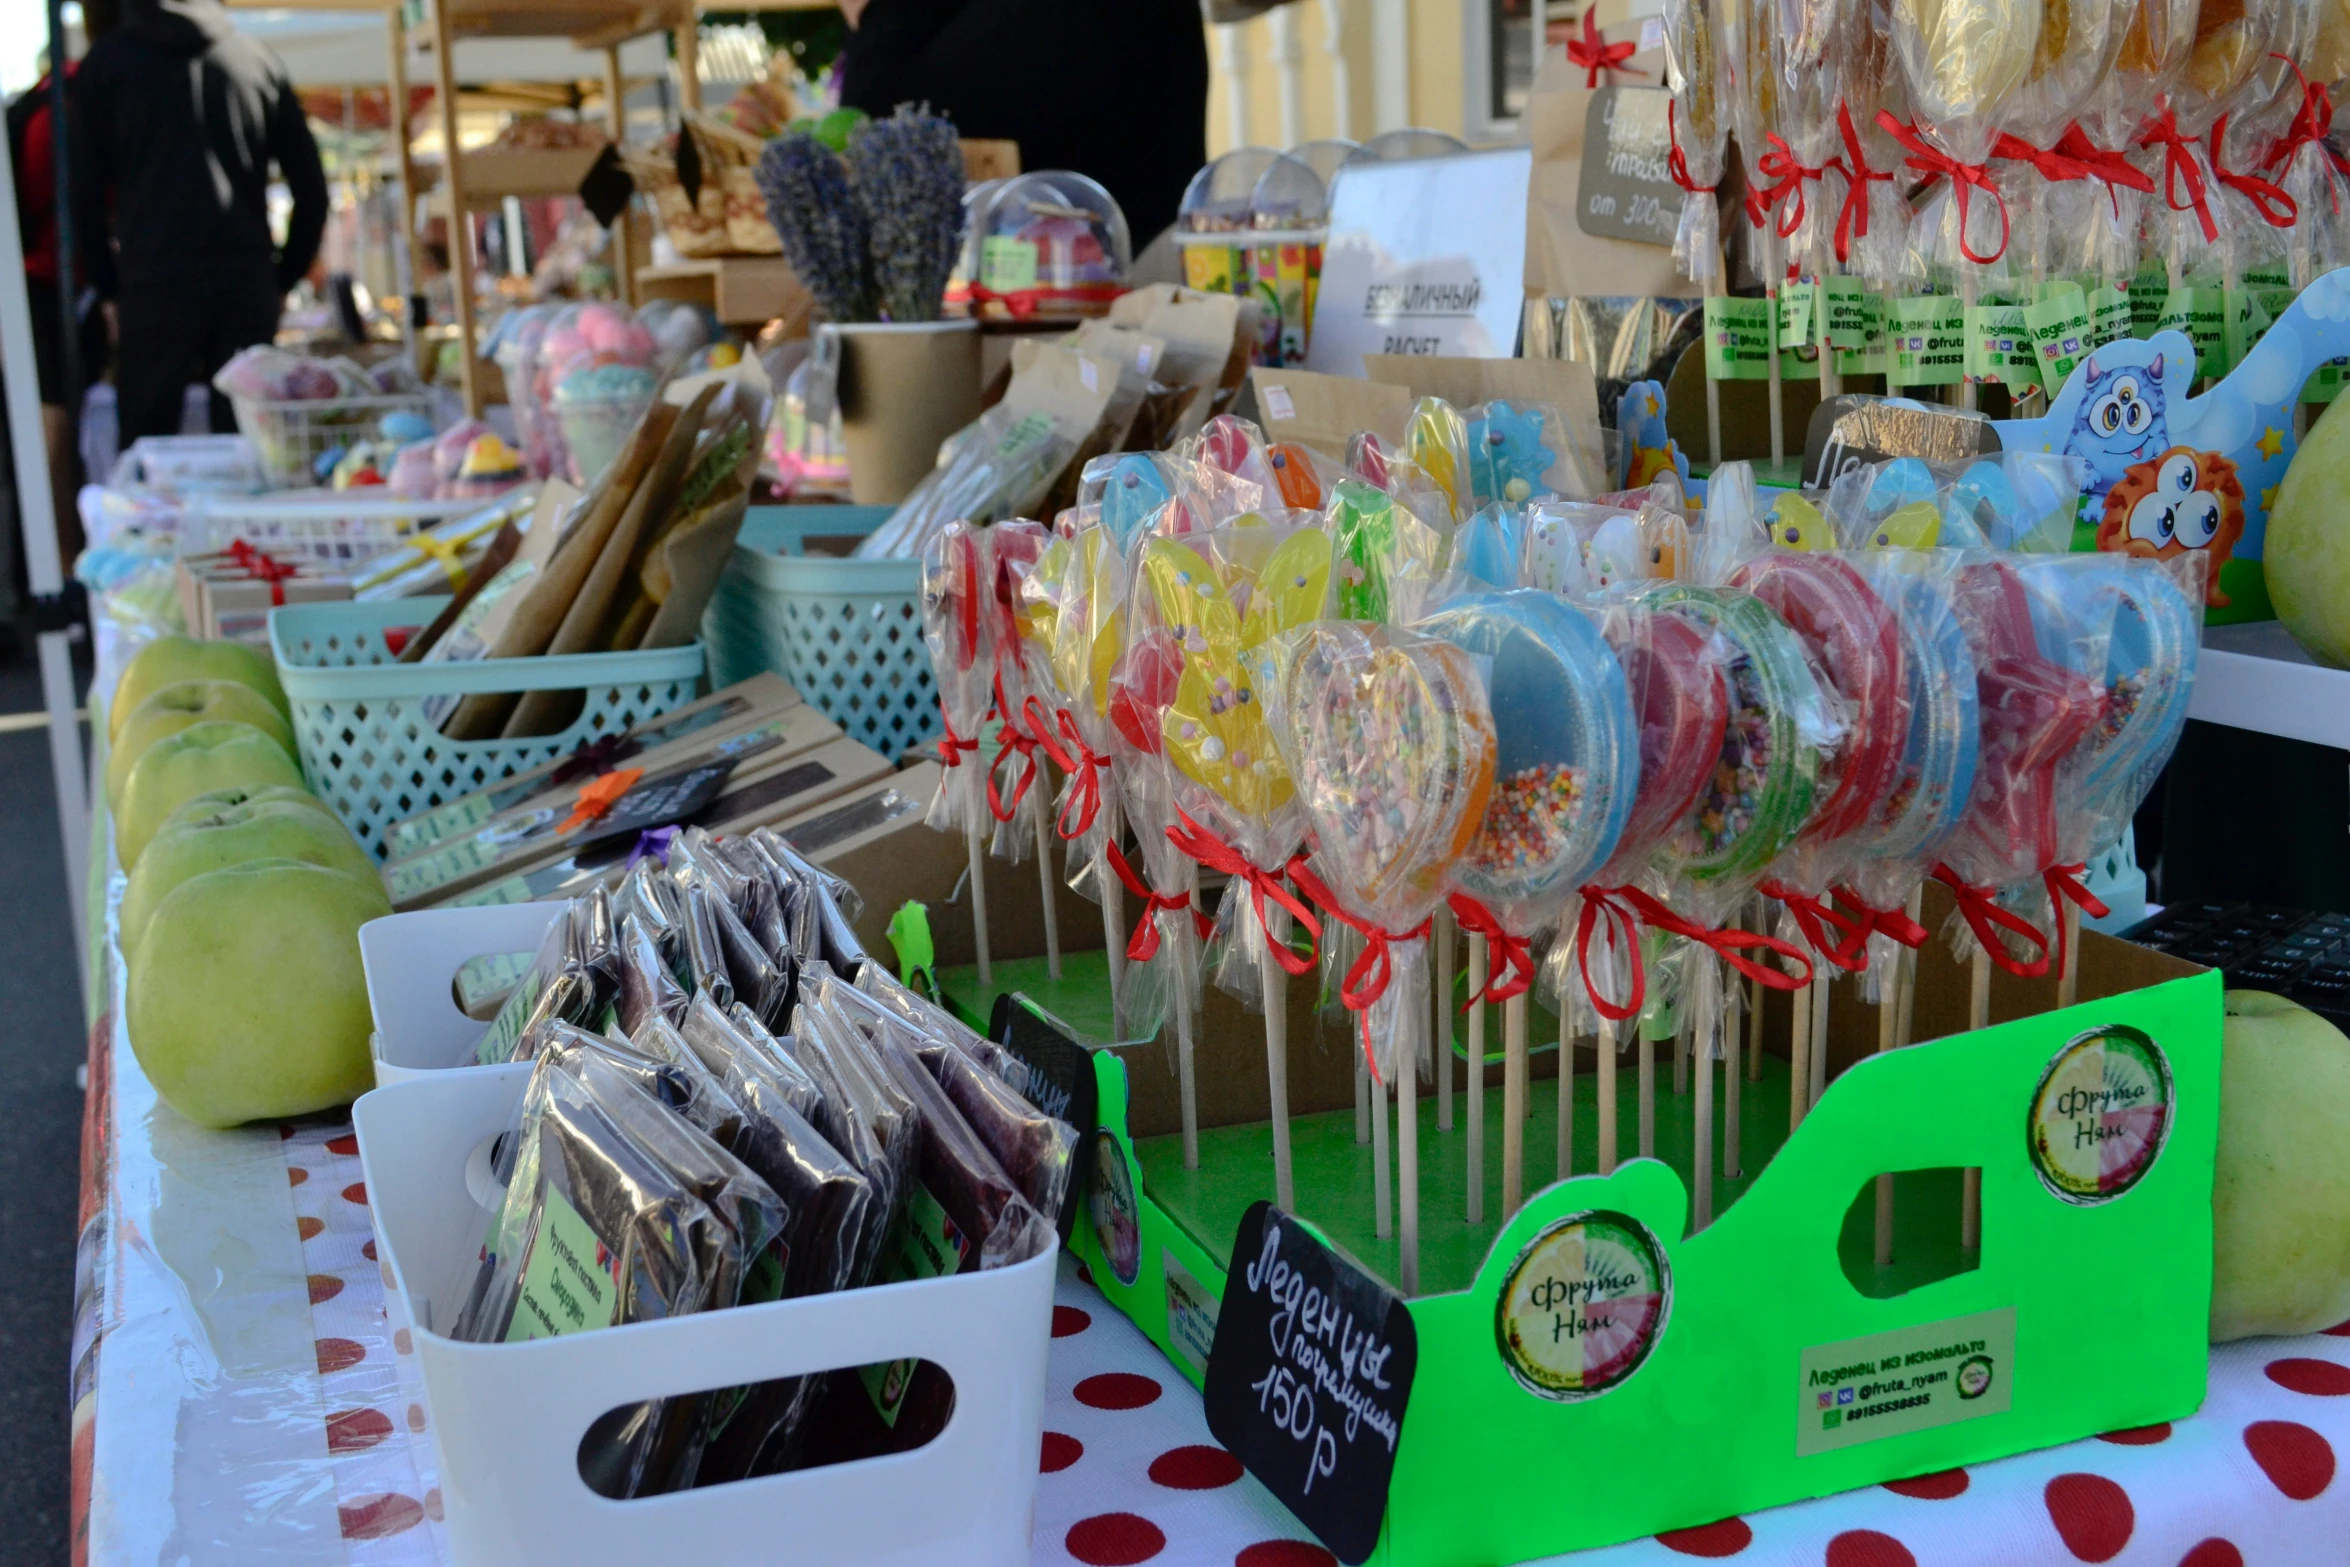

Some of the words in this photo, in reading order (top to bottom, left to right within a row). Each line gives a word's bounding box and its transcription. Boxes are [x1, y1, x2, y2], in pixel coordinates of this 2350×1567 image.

[1888, 318, 1942, 333] Леденец
[1979, 323, 2027, 338] Леденец
[2031, 314, 2089, 342] Леденец
[2058, 1083, 2149, 1120] Фрута
[2074, 1117, 2128, 1150] Ням
[1247, 1226, 1392, 1390] Леденцы
[1531, 1273, 1640, 1313] Фрута
[1552, 1309, 1617, 1344] Ням
[1808, 1361, 1877, 1387] Леденец
[1880, 1355, 1901, 1372] из
[1904, 1339, 1986, 1367] изомальта
[1858, 1370, 1948, 1400] @fruta_nyam
